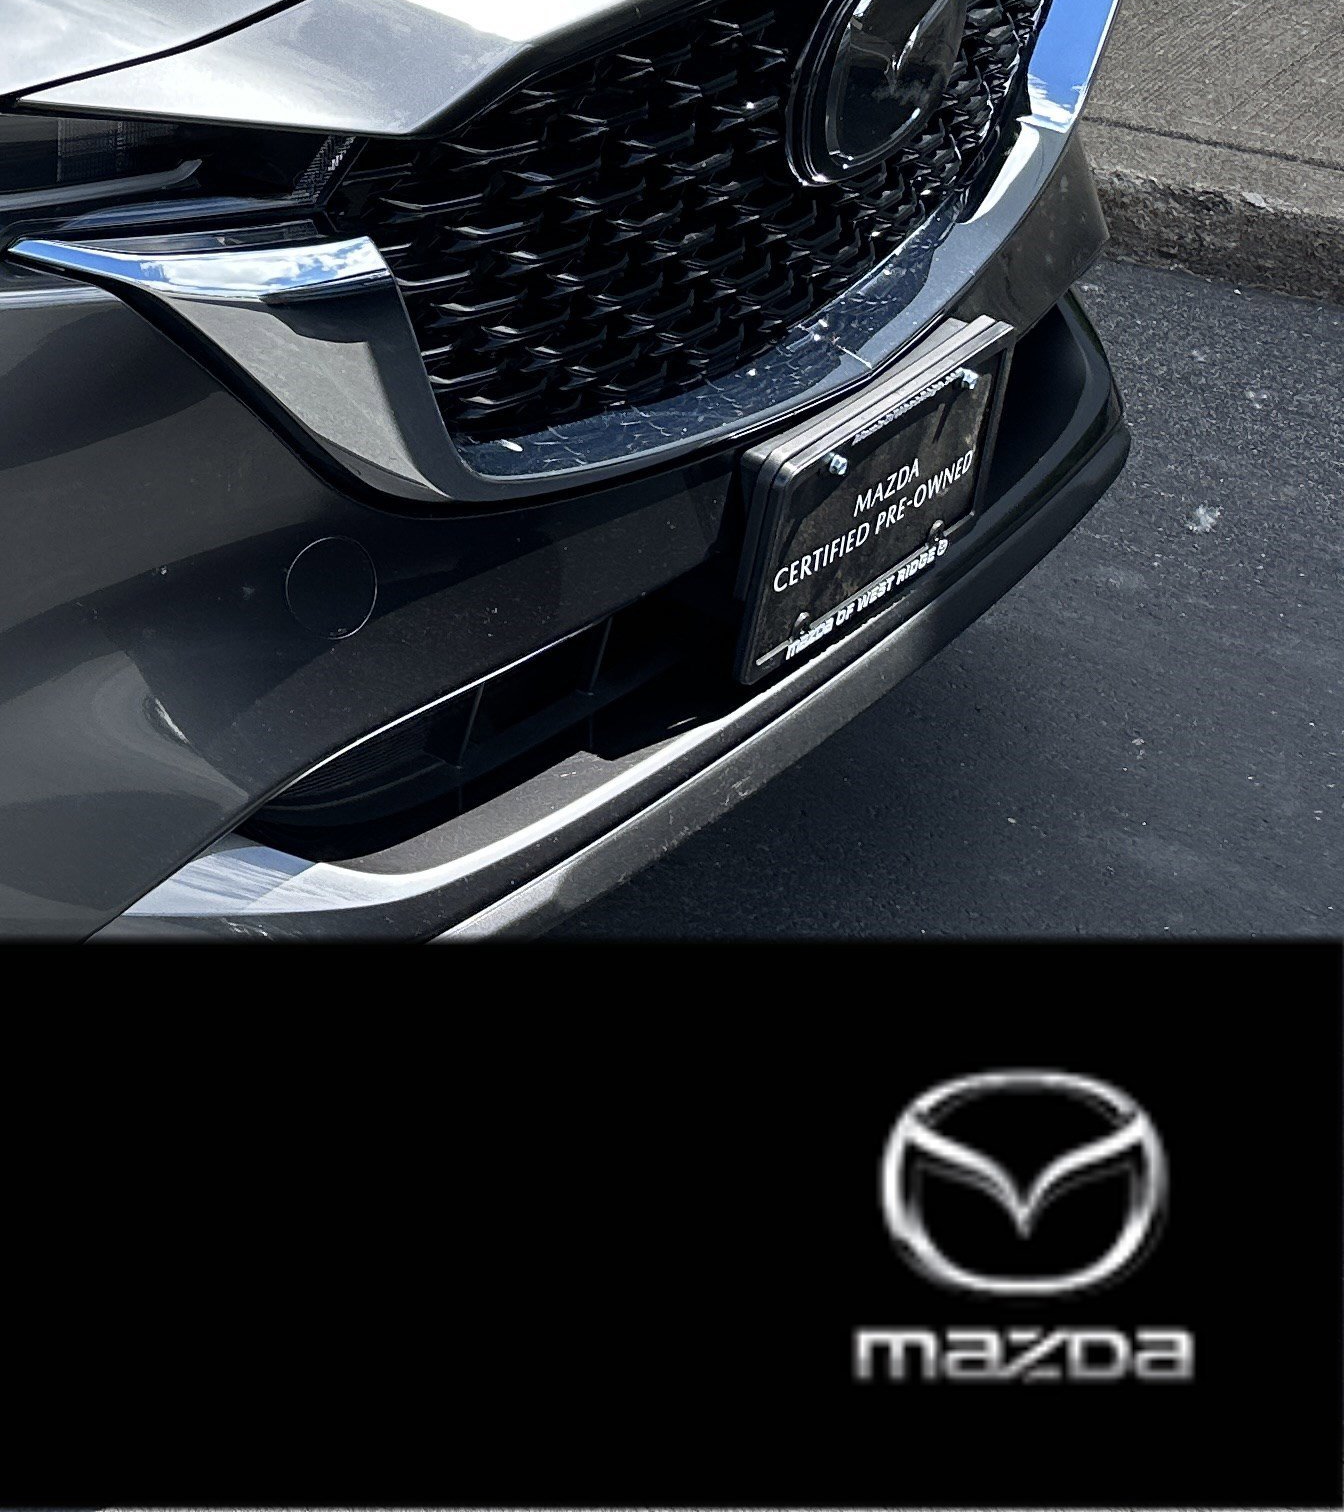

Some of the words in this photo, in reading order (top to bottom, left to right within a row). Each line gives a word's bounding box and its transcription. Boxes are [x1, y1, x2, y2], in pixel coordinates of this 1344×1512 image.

[773, 522, 870, 593] CERTIFIED
[874, 449, 974, 535] PRE-OWNED
[853, 458, 919, 518] MAZDA
[835, 603, 856, 626] OF
[856, 574, 896, 612] WEST
[895, 545, 937, 586] RIDGE
